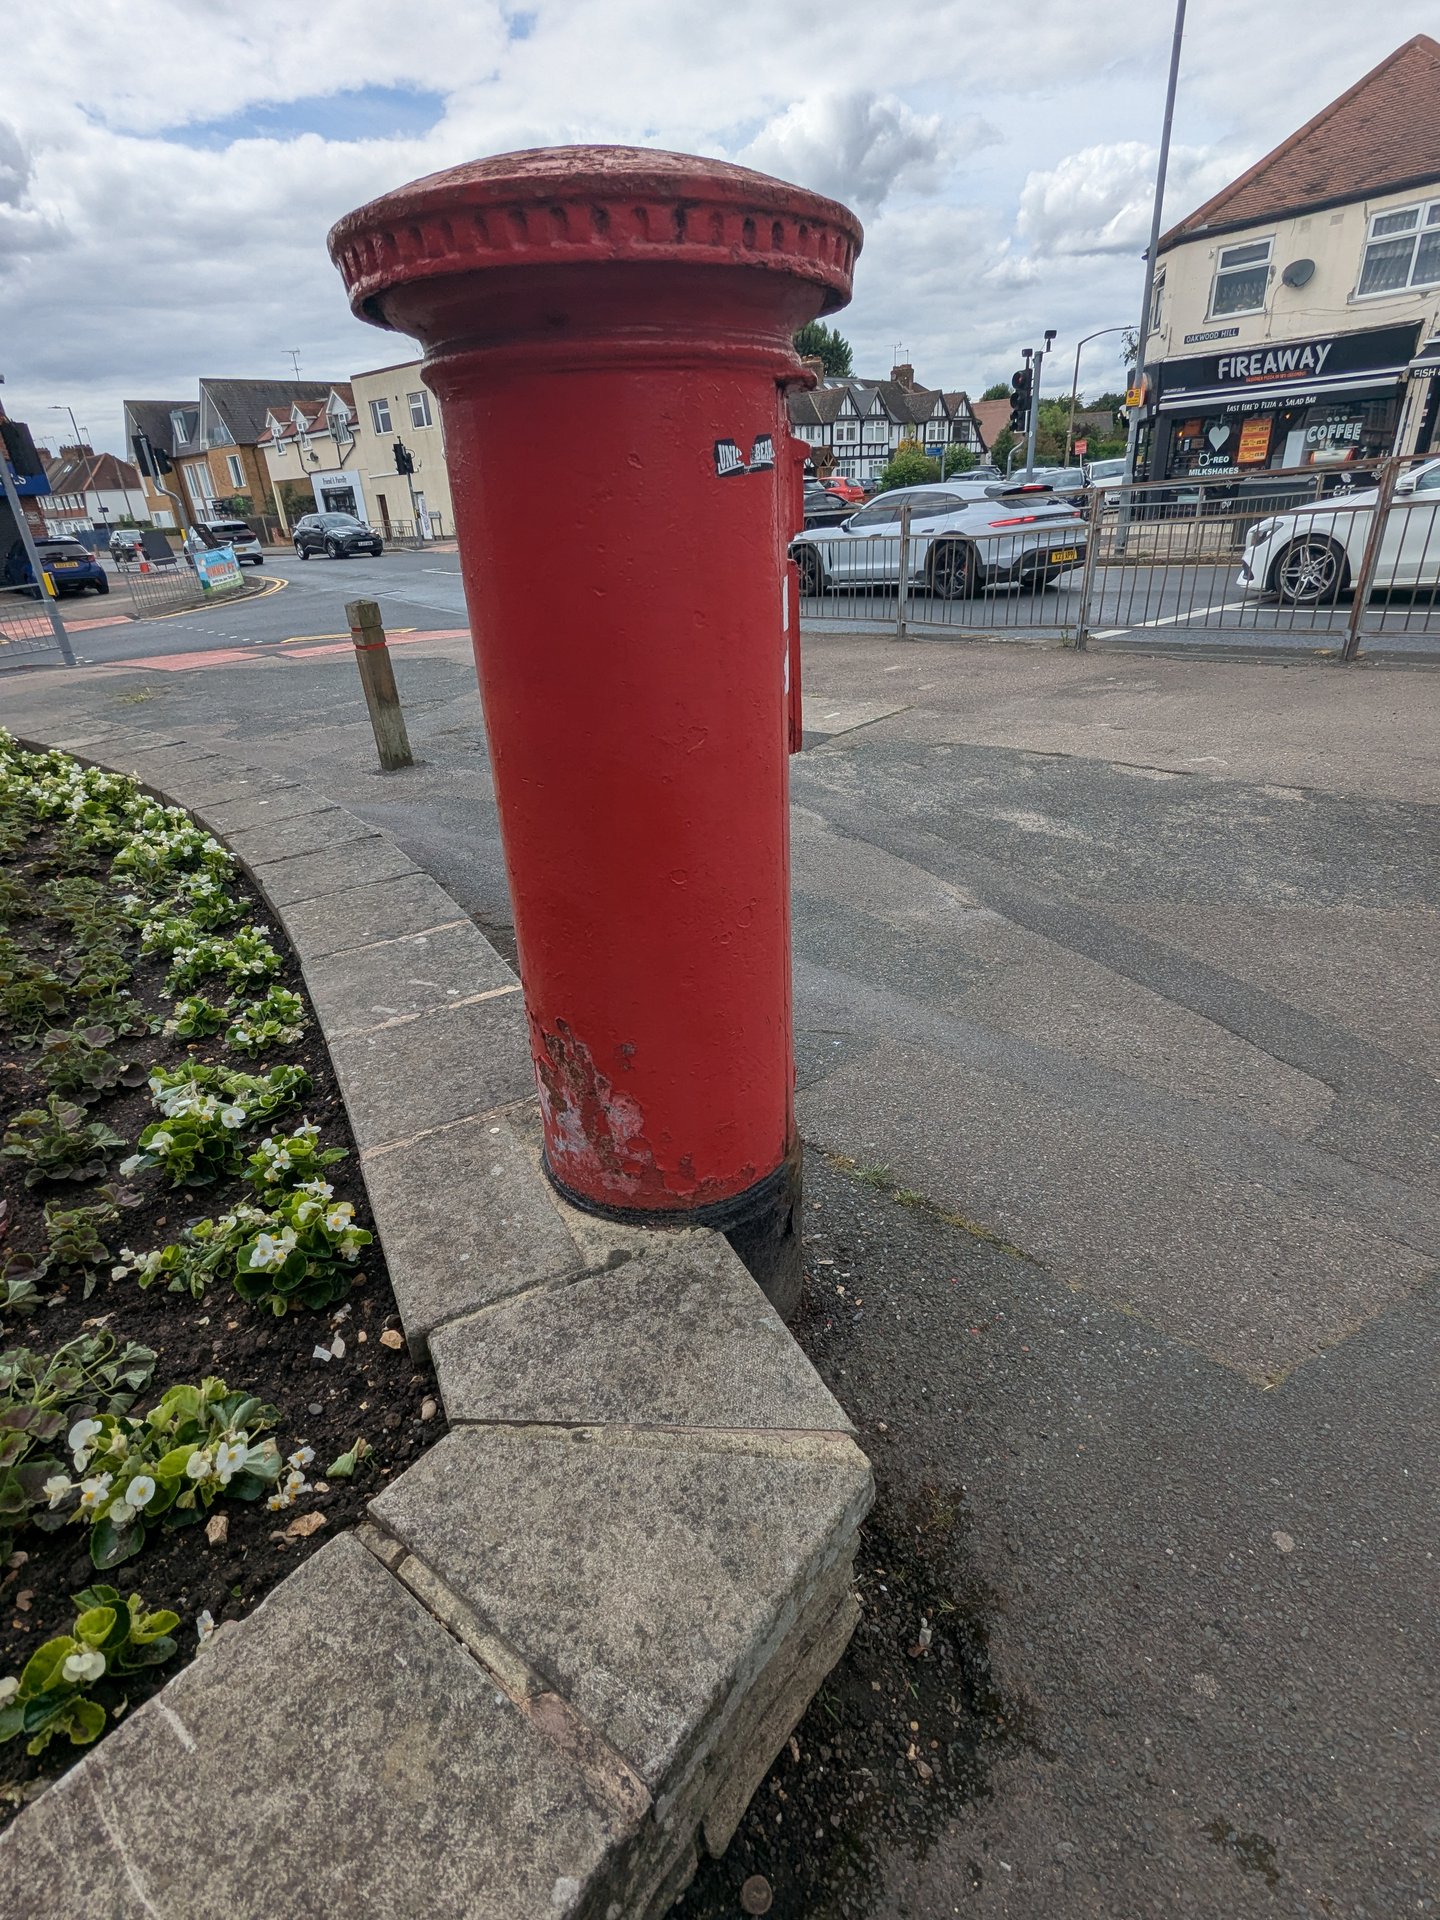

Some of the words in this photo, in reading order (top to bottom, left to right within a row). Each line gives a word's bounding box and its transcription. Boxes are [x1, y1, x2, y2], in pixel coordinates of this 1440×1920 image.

[1186, 331, 1219, 343] OAKWOOD
[1220, 328, 1237, 338] HILL
[1217, 343, 1333, 380] FIREAWAY
[1414, 368, 1436, 378] FISH
[1226, 404, 1239, 413] FAST
[1260, 401, 1277, 409] PIZZA
[1285, 397, 1304, 407] SALAD
[1304, 396, 1317, 404] BAR
[1306, 422, 1363, 443] COFFEE
[1188, 466, 1240, 476] MILKSHAKES
